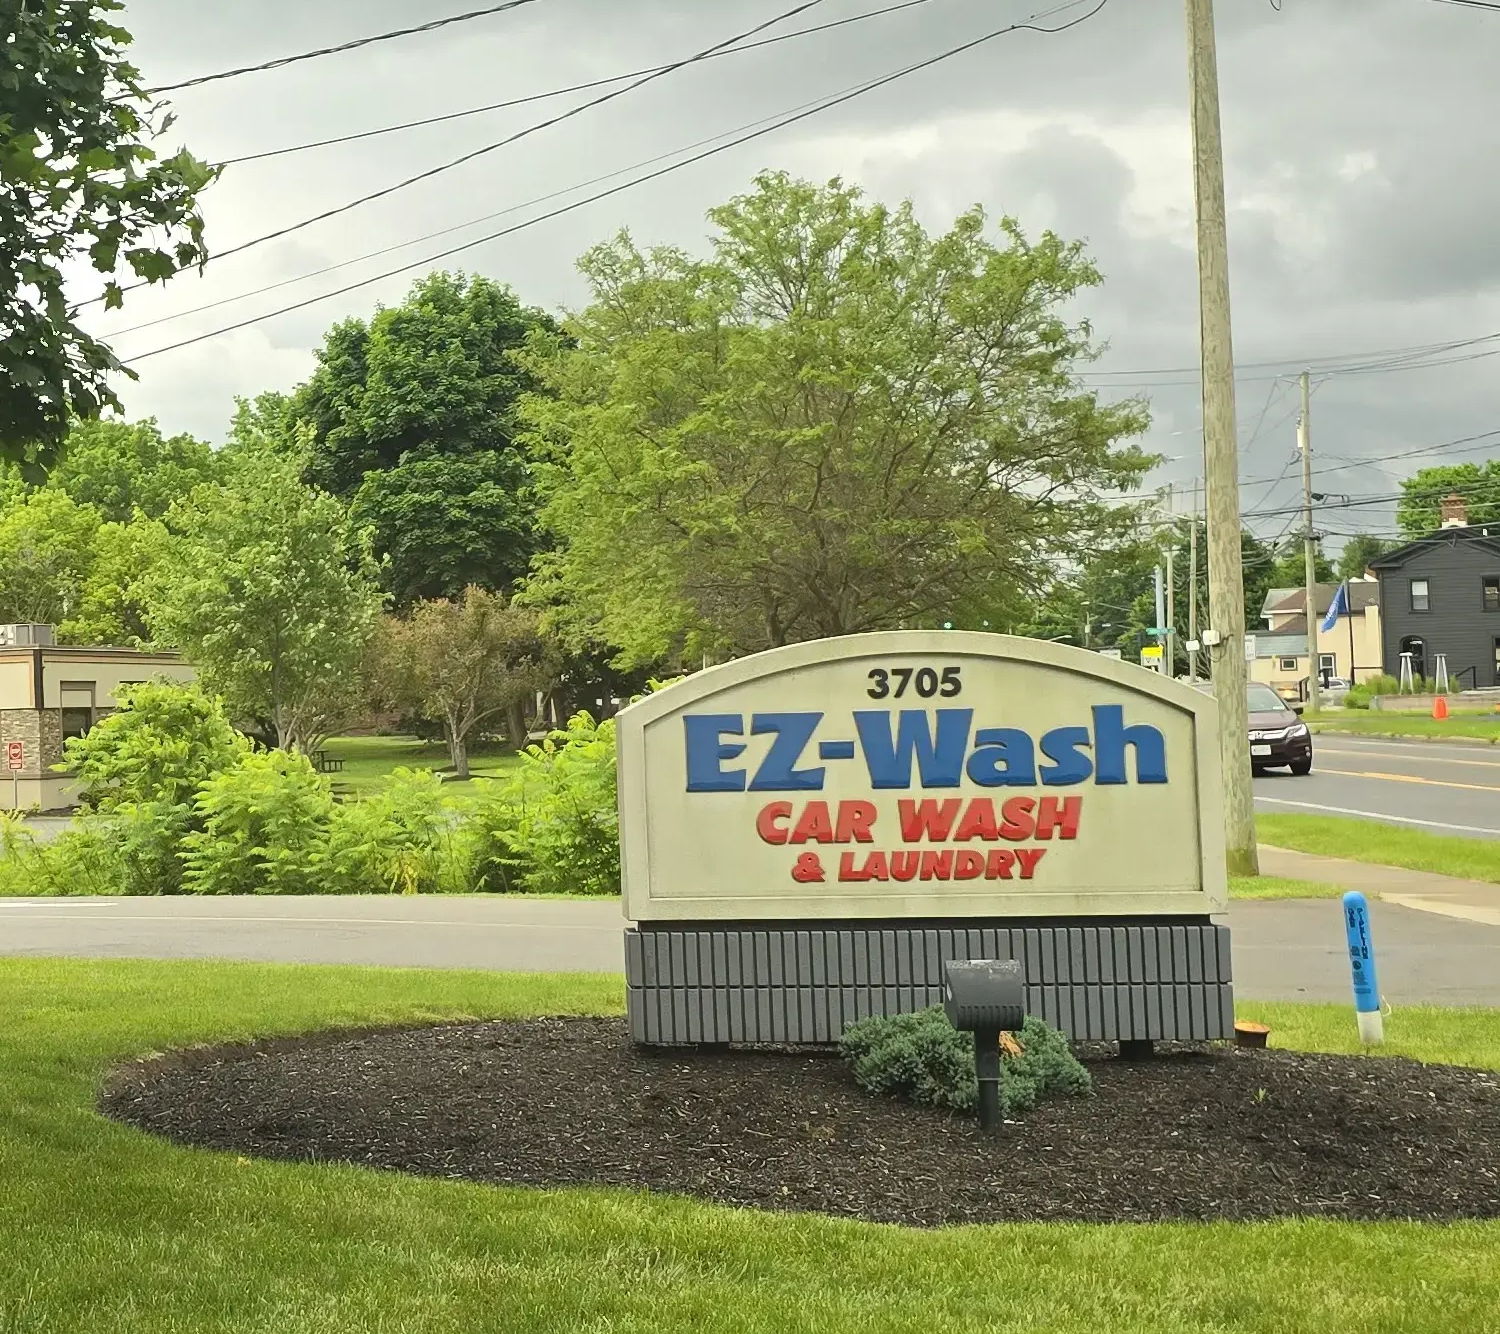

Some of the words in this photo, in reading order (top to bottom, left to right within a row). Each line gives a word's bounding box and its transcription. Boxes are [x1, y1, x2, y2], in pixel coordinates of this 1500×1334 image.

[866, 666, 963, 700] 3705
[684, 704, 1169, 792] EZ-Wash
[756, 800, 878, 845] CAR
[898, 795, 1083, 843] WASH
[791, 850, 827, 883] &
[838, 848, 1047, 882] LAUNDRY
